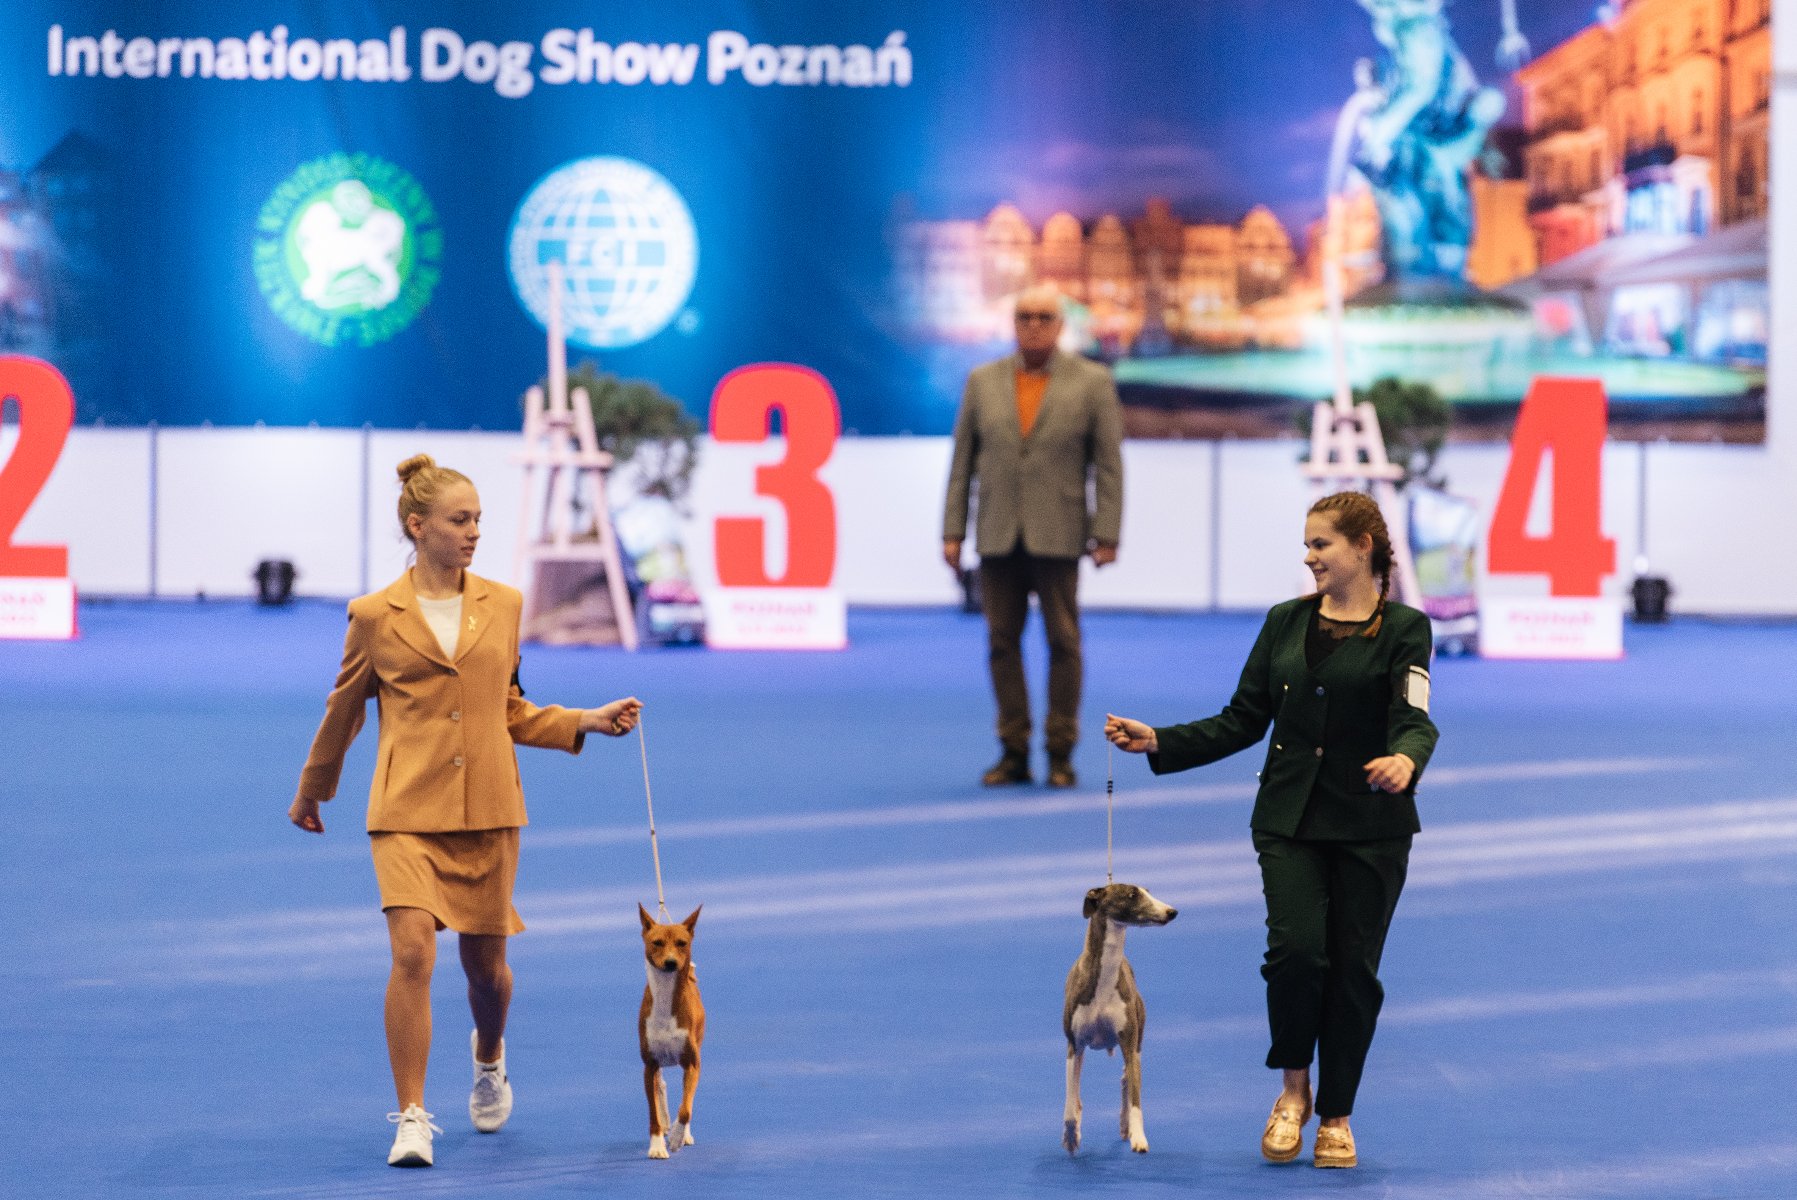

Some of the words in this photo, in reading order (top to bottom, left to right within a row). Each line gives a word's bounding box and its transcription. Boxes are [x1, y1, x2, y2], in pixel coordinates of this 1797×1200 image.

[47, 25, 410, 81] International
[421, 28, 534, 97] Dog
[540, 28, 699, 85] Show
[706, 28, 913, 88] Poznań
[565, 238, 638, 268] FCI
[0, 355, 75, 578] 2
[710, 364, 840, 588] 3
[1487, 377, 1616, 598] 4
